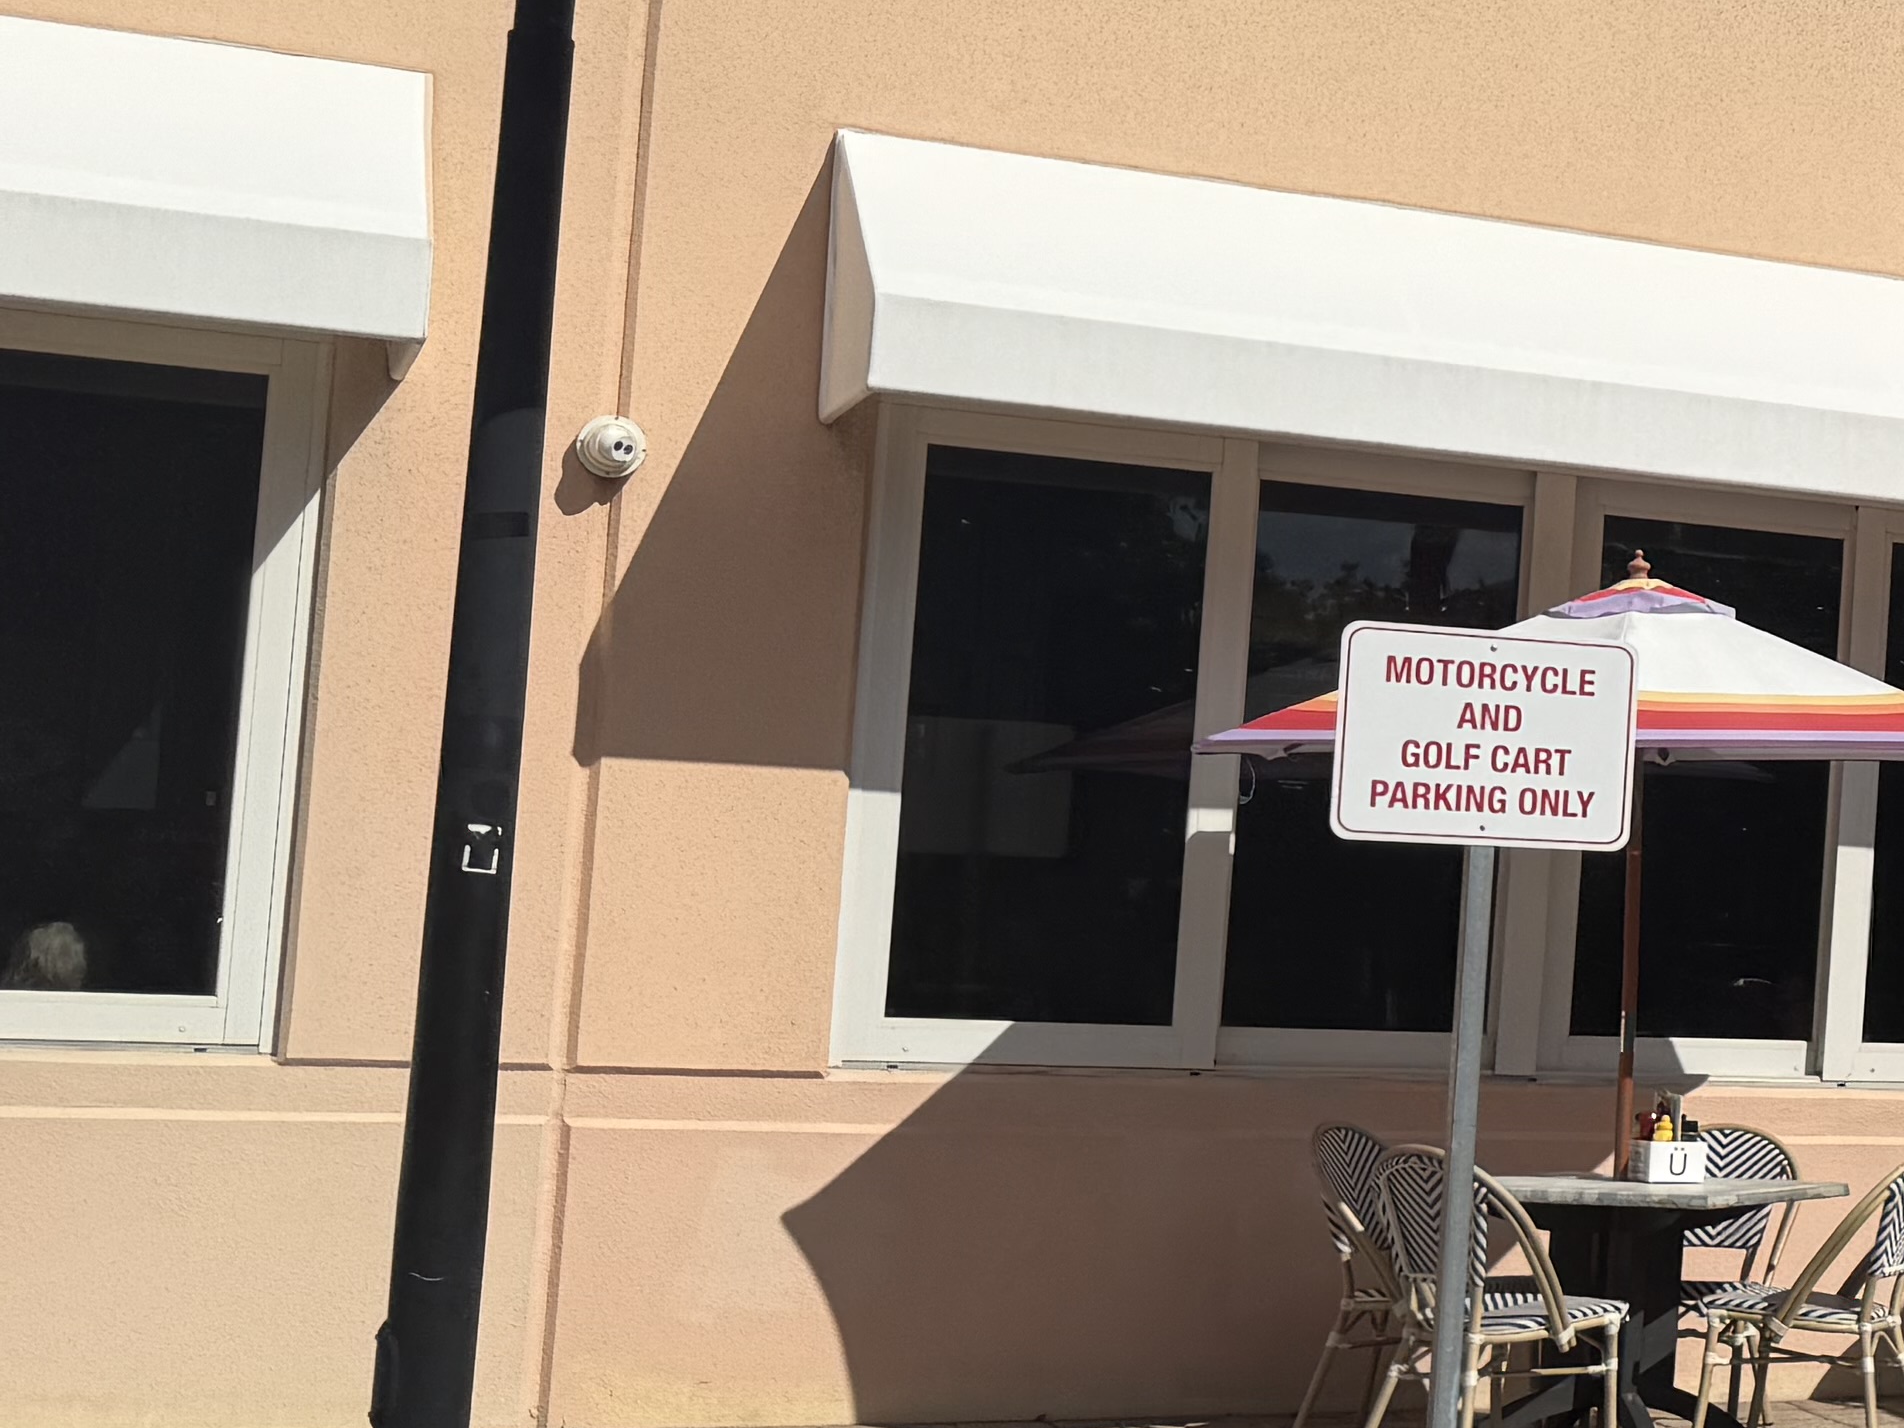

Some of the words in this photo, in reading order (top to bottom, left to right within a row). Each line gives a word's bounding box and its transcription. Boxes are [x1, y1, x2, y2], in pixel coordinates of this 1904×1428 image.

[1384, 654, 1597, 698] MOTORCYCLE
[1456, 702, 1523, 733] AND
[1400, 739, 1481, 771] GOLF
[1490, 745, 1572, 777] CART
[1369, 779, 1507, 815] PARKING
[1517, 788, 1596, 819] ONLY
